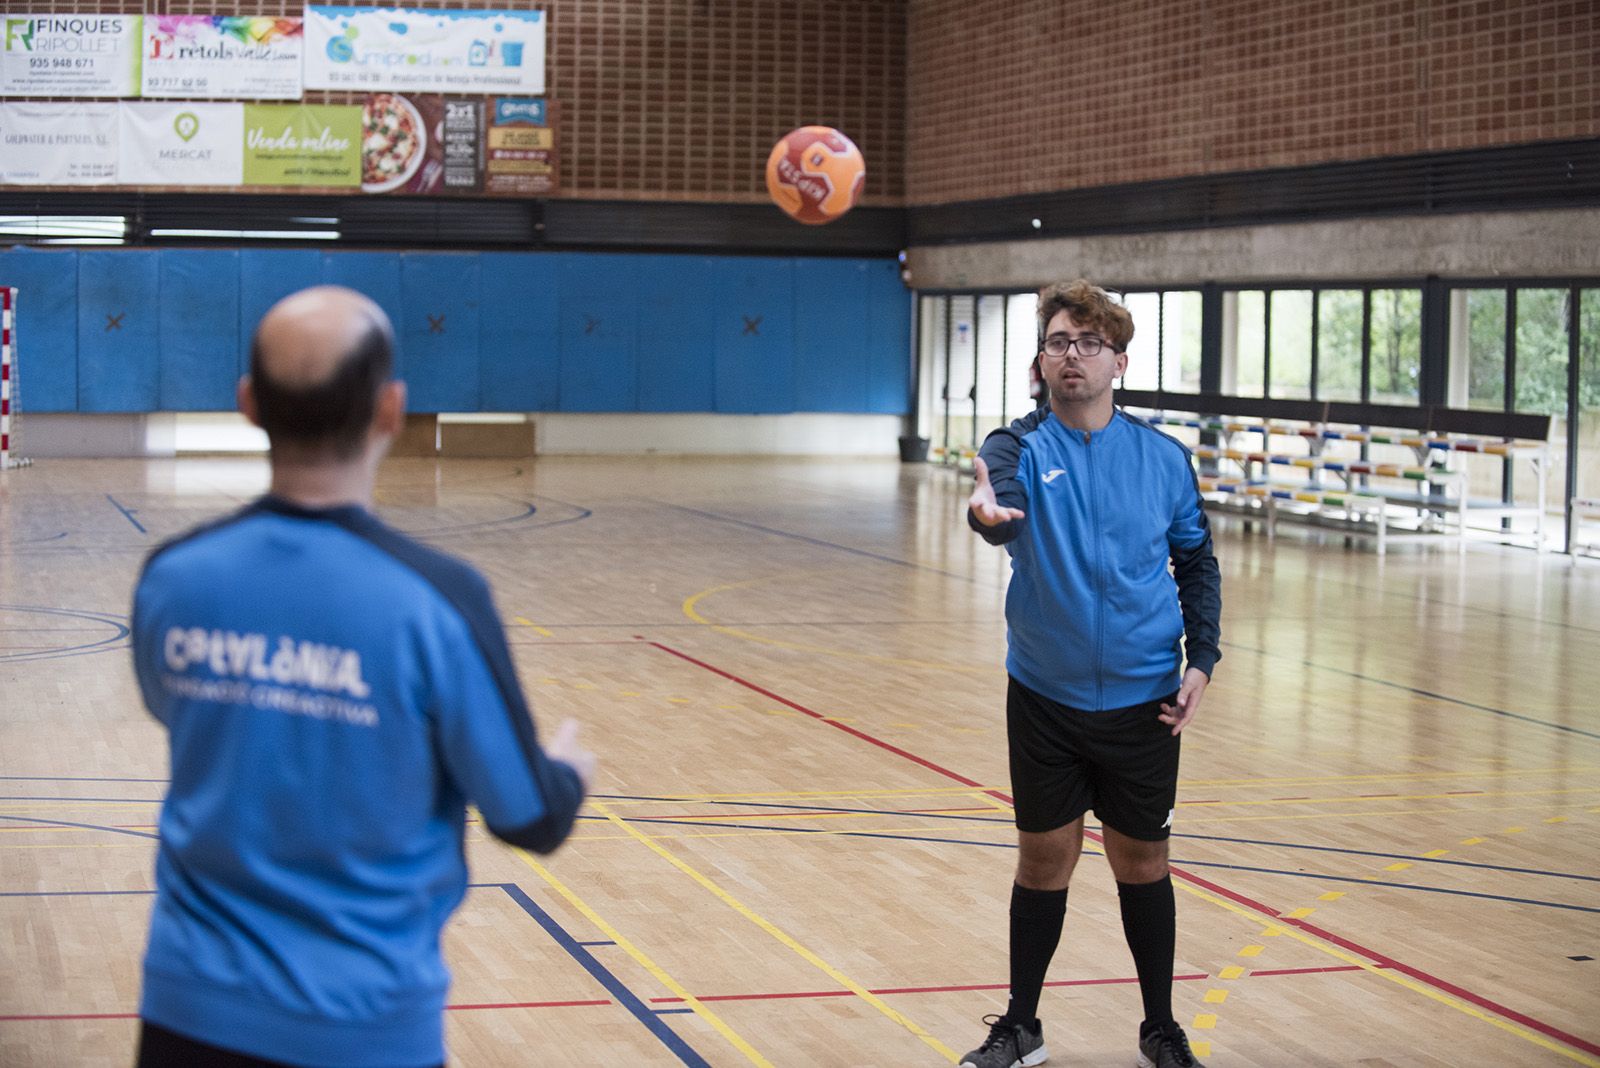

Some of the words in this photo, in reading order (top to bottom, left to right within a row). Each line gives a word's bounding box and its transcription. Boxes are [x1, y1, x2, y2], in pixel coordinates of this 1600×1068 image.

[37, 19, 122, 35] FINQUES
[36, 37, 121, 52] RIPOLLET
[29, 58, 49, 68] 935
[52, 58, 72, 68] 948
[75, 58, 94, 68] 671
[247, 125, 297, 150] Venda
[301, 125, 350, 151] online
[159, 149, 213, 160] MERCAT
